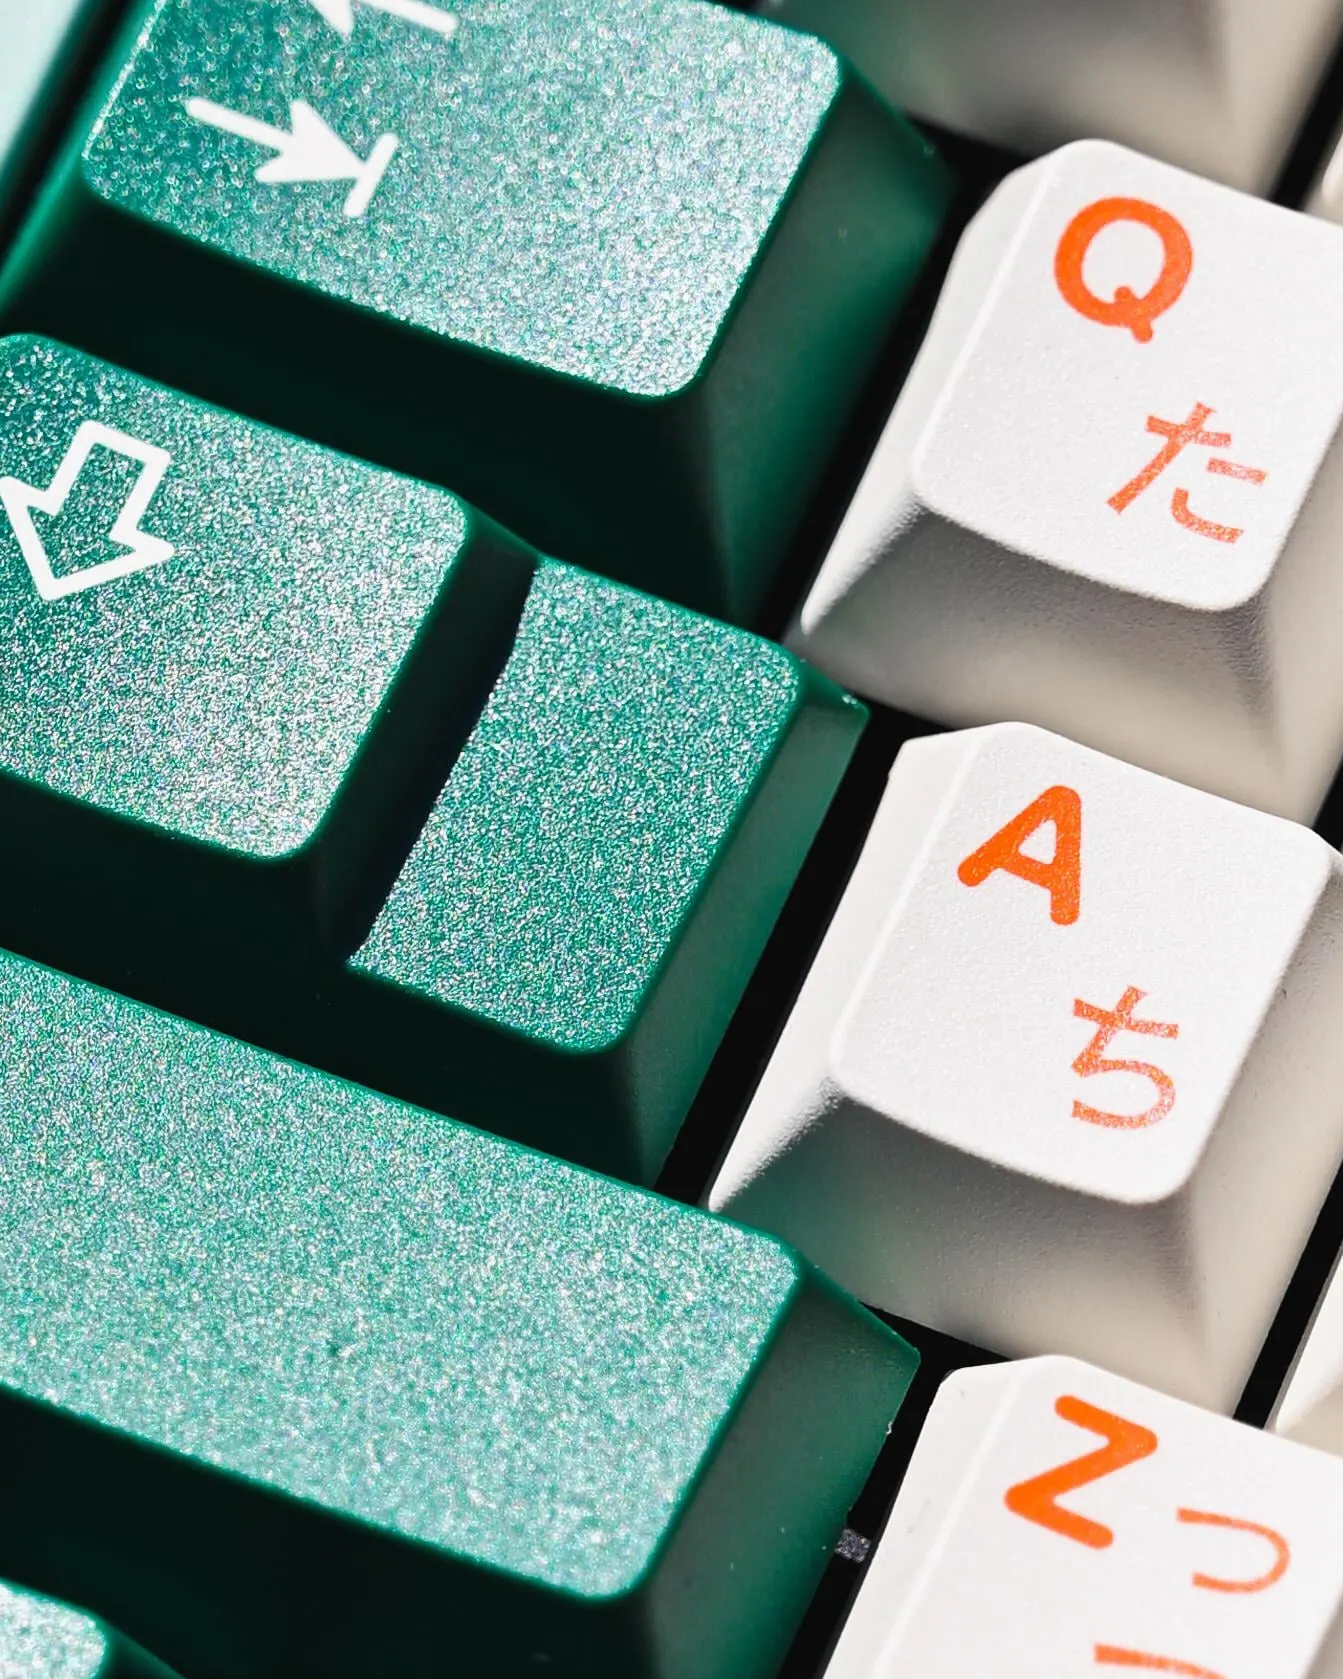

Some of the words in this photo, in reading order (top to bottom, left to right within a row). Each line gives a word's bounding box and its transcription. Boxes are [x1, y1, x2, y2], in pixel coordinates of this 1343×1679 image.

[1051, 194, 1196, 346] Q
[1106, 401, 1266, 544] た
[955, 782, 1084, 928] A
[1070, 985, 1181, 1129] ち
[1001, 1393, 1160, 1551] Z
